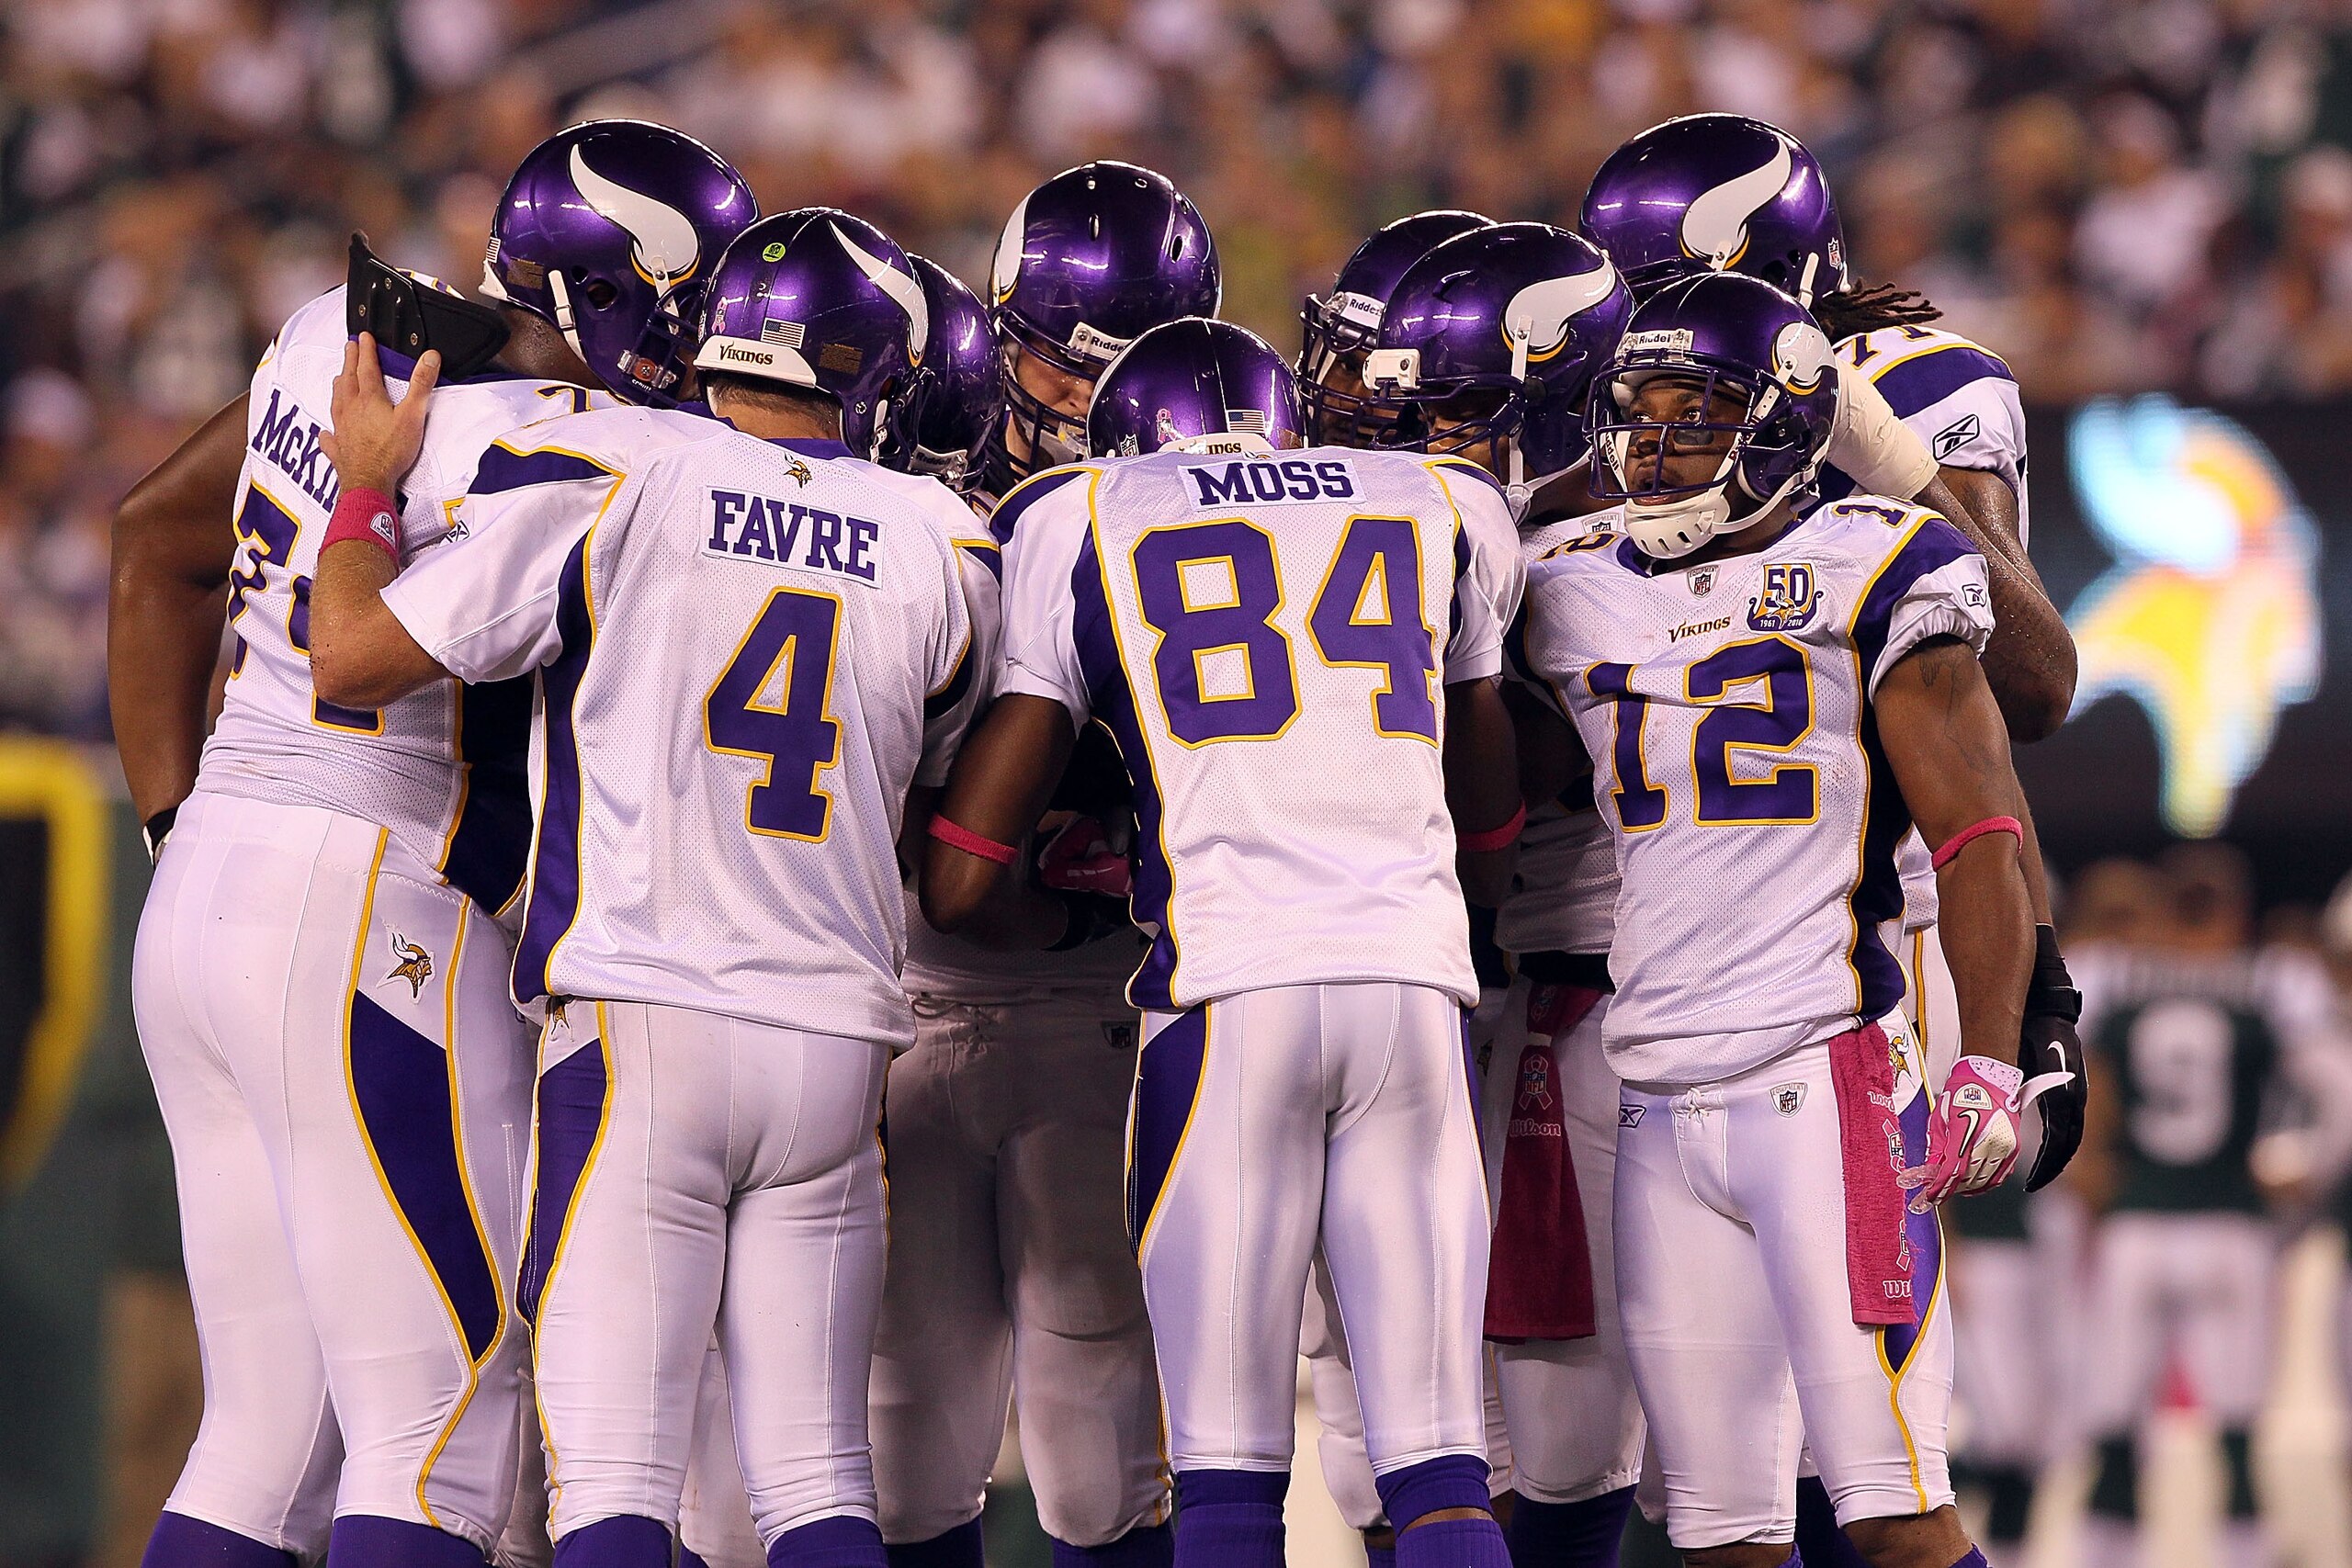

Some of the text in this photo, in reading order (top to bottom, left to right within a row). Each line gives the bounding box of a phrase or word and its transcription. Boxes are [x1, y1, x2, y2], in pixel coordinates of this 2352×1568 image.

[1188, 462, 1354, 505] MOSS
[708, 491, 878, 581] FAVRE
[1128, 514, 1440, 749] 84
[1760, 618, 1803, 628] 1961 2010
[1765, 568, 1810, 608] 50
[704, 586, 842, 843] 4
[1584, 633, 1820, 834] 12
[2126, 996, 2236, 1168] 9
[1510, 1118, 1561, 1137] Wilson
